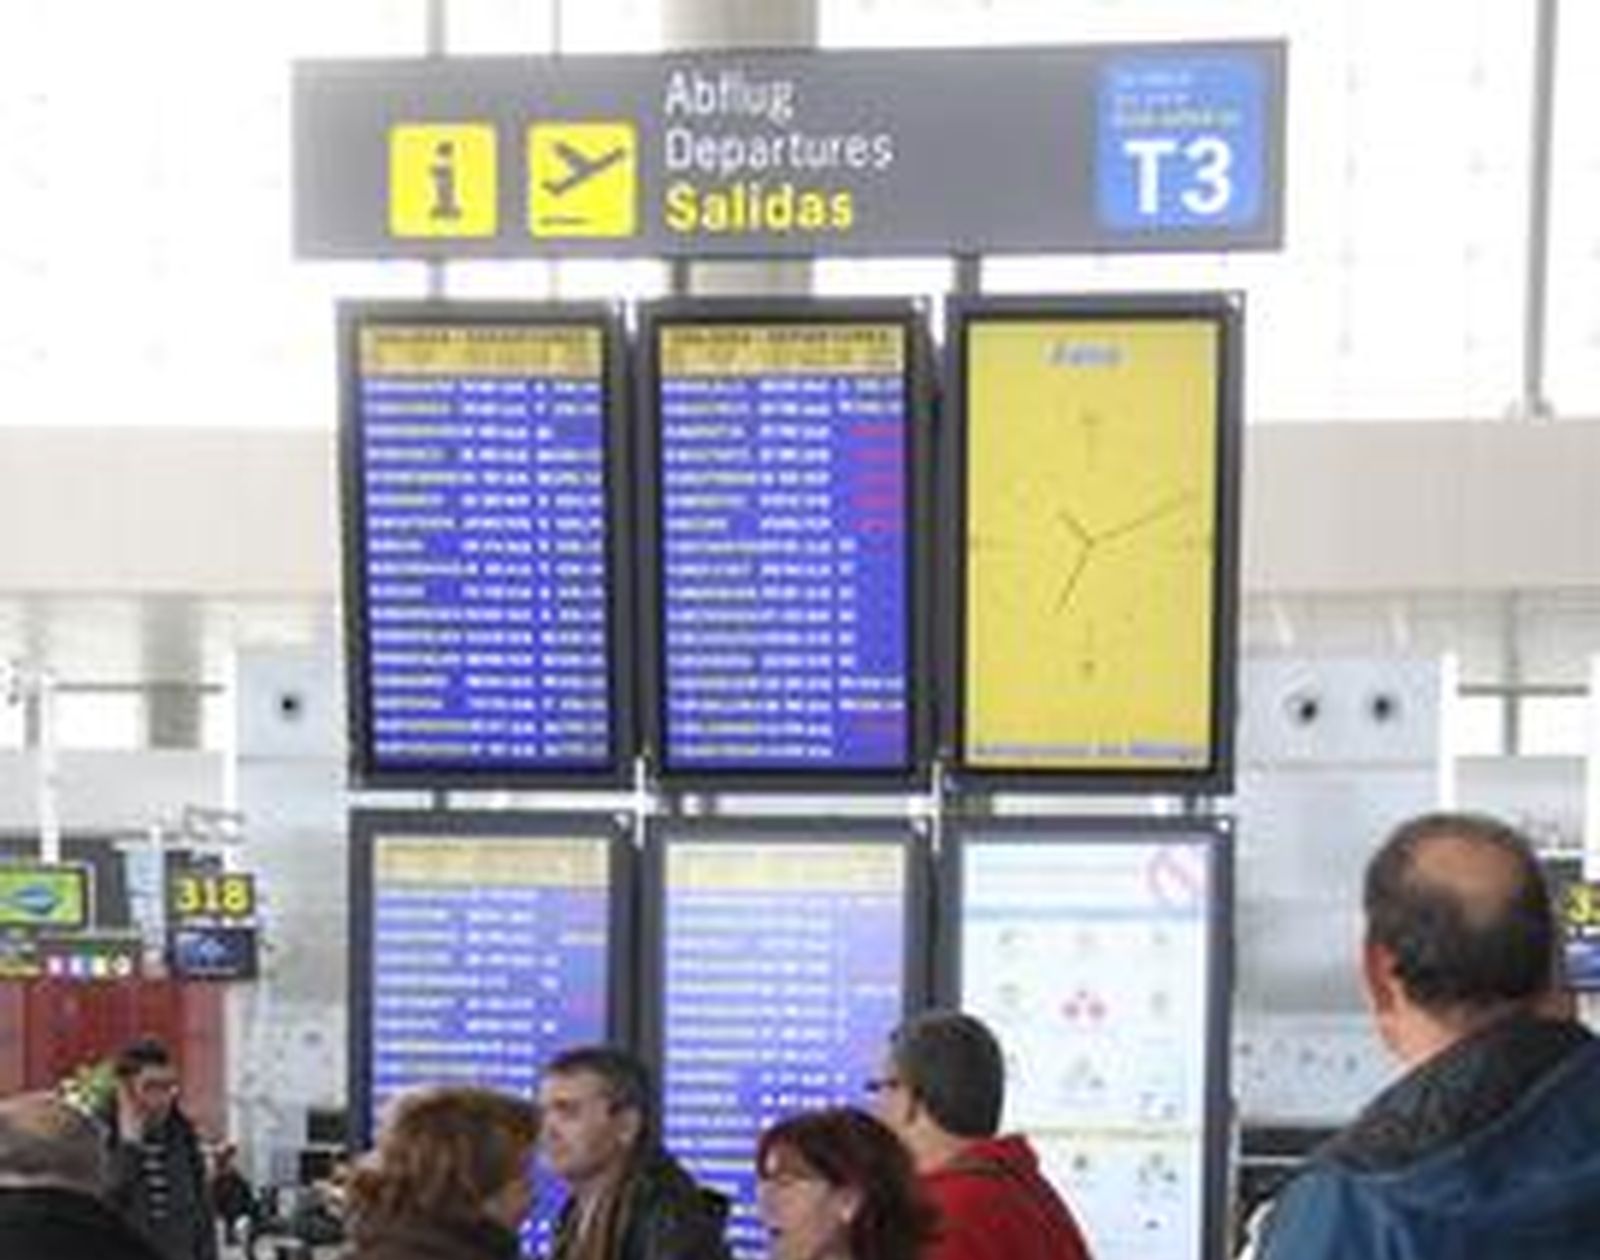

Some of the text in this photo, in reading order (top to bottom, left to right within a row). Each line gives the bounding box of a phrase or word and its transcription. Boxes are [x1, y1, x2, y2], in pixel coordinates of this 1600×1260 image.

[665, 127, 893, 176] Departures
[1123, 135, 1232, 214] T3
[665, 181, 853, 231] Salidas
[177, 878, 249, 911] 318
